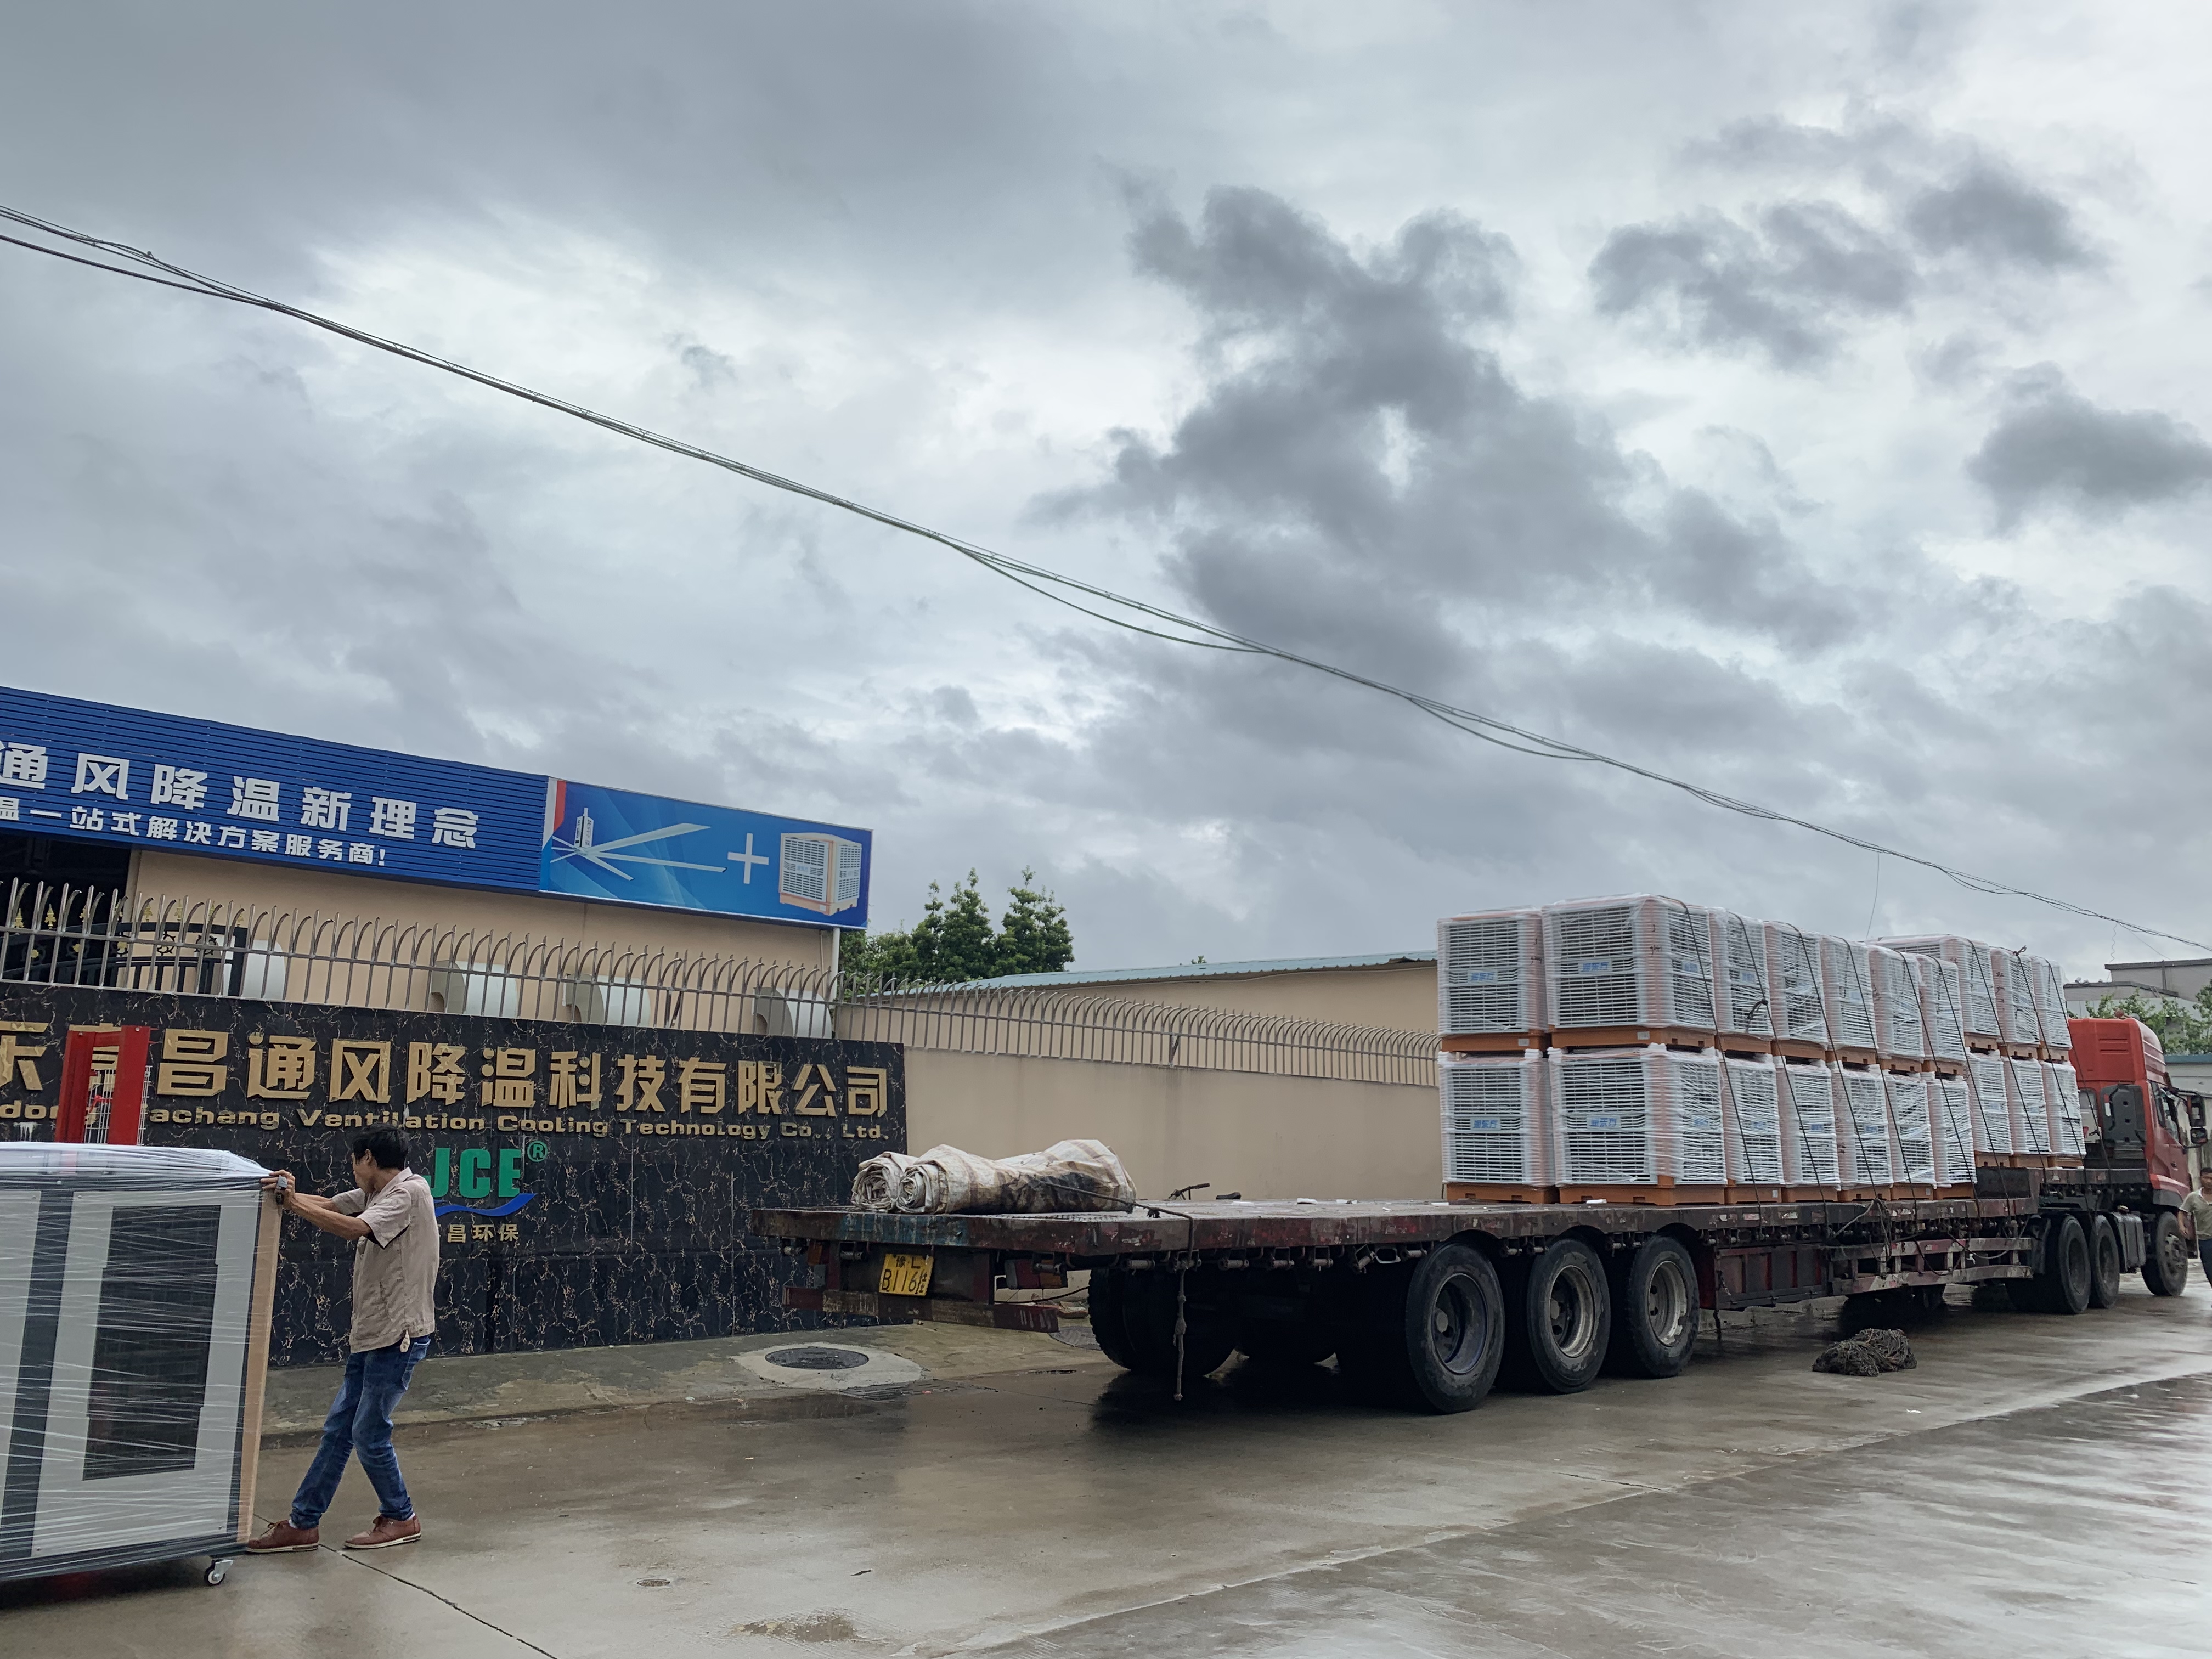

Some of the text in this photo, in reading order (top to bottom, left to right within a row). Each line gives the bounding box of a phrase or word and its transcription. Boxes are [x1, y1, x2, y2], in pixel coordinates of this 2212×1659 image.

[0, 742, 478, 849] 通风降温新理念
[143, 1103, 280, 1130] achang
[297, 1109, 485, 1130] Ventilation
[498, 1115, 608, 1138] Cooling
[619, 1119, 770, 1140] Technology
[842, 1123, 889, 1139] Ltd.
[438, 1224, 519, 1243] 昌环保
